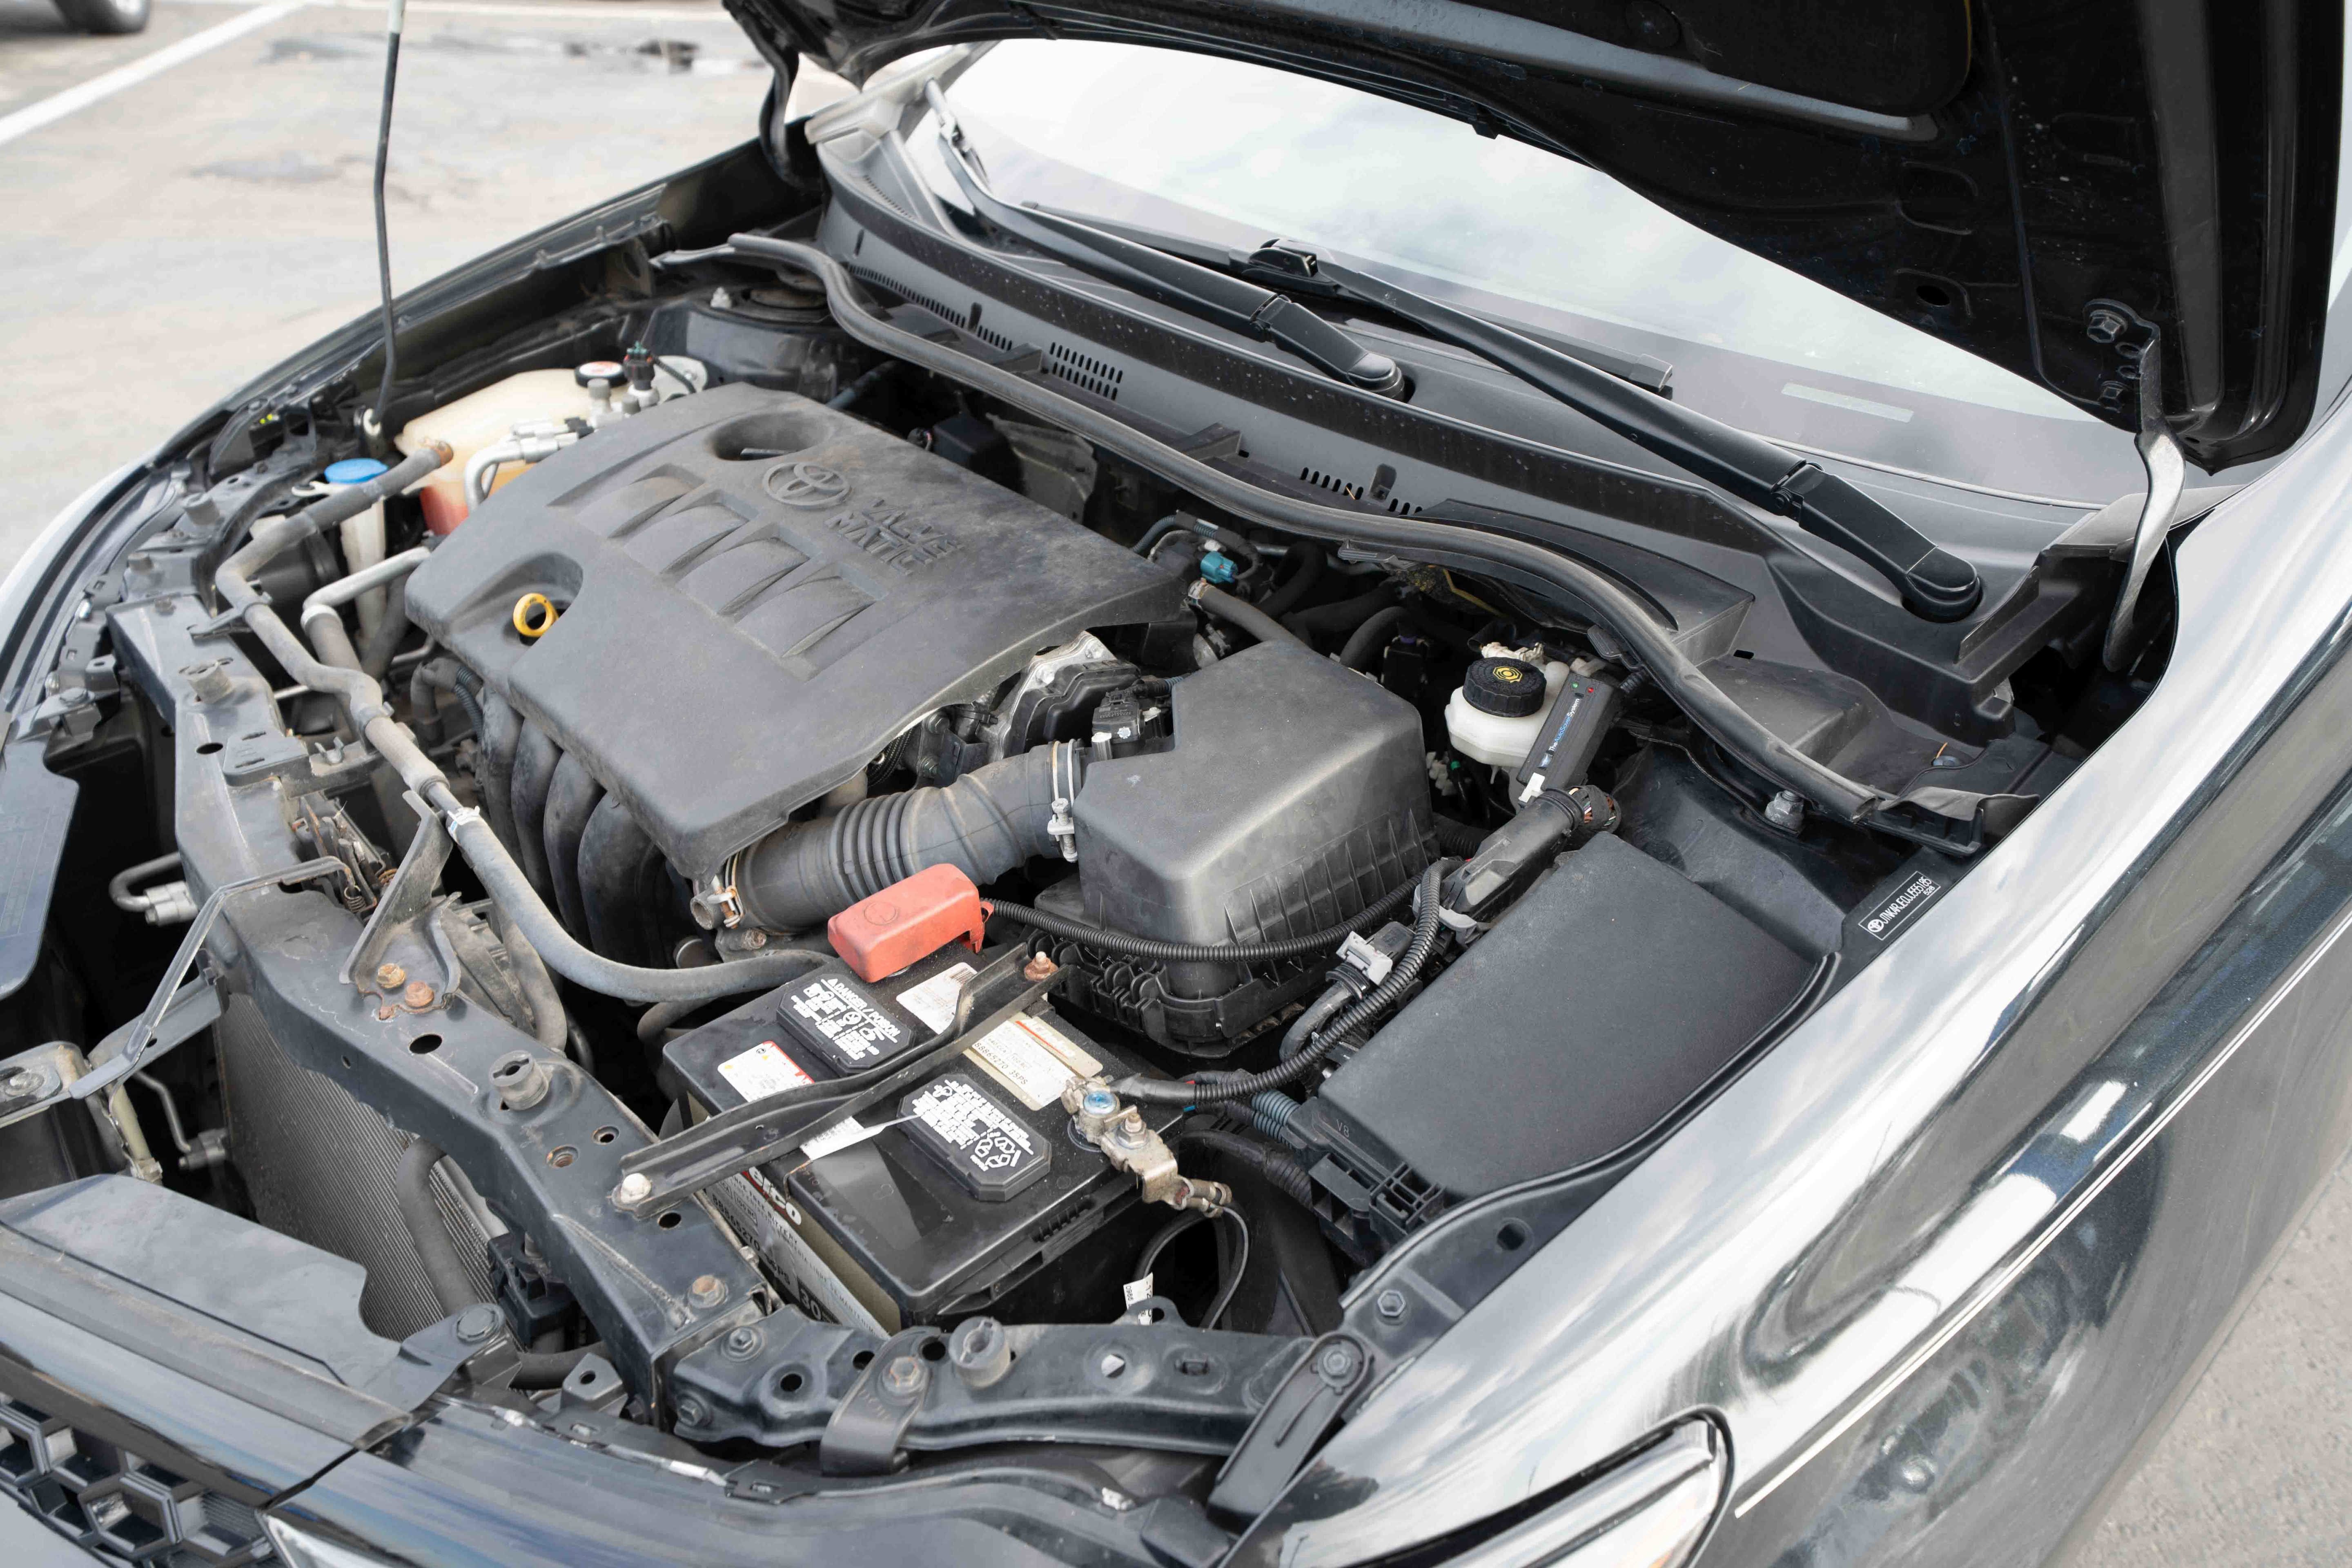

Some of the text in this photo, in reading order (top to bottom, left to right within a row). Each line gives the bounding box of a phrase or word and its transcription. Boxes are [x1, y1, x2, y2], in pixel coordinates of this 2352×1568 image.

[835, 983, 867, 1010] DANGER
[868, 1011, 901, 1037] POISON
[800, 1287, 822, 1321] 30
